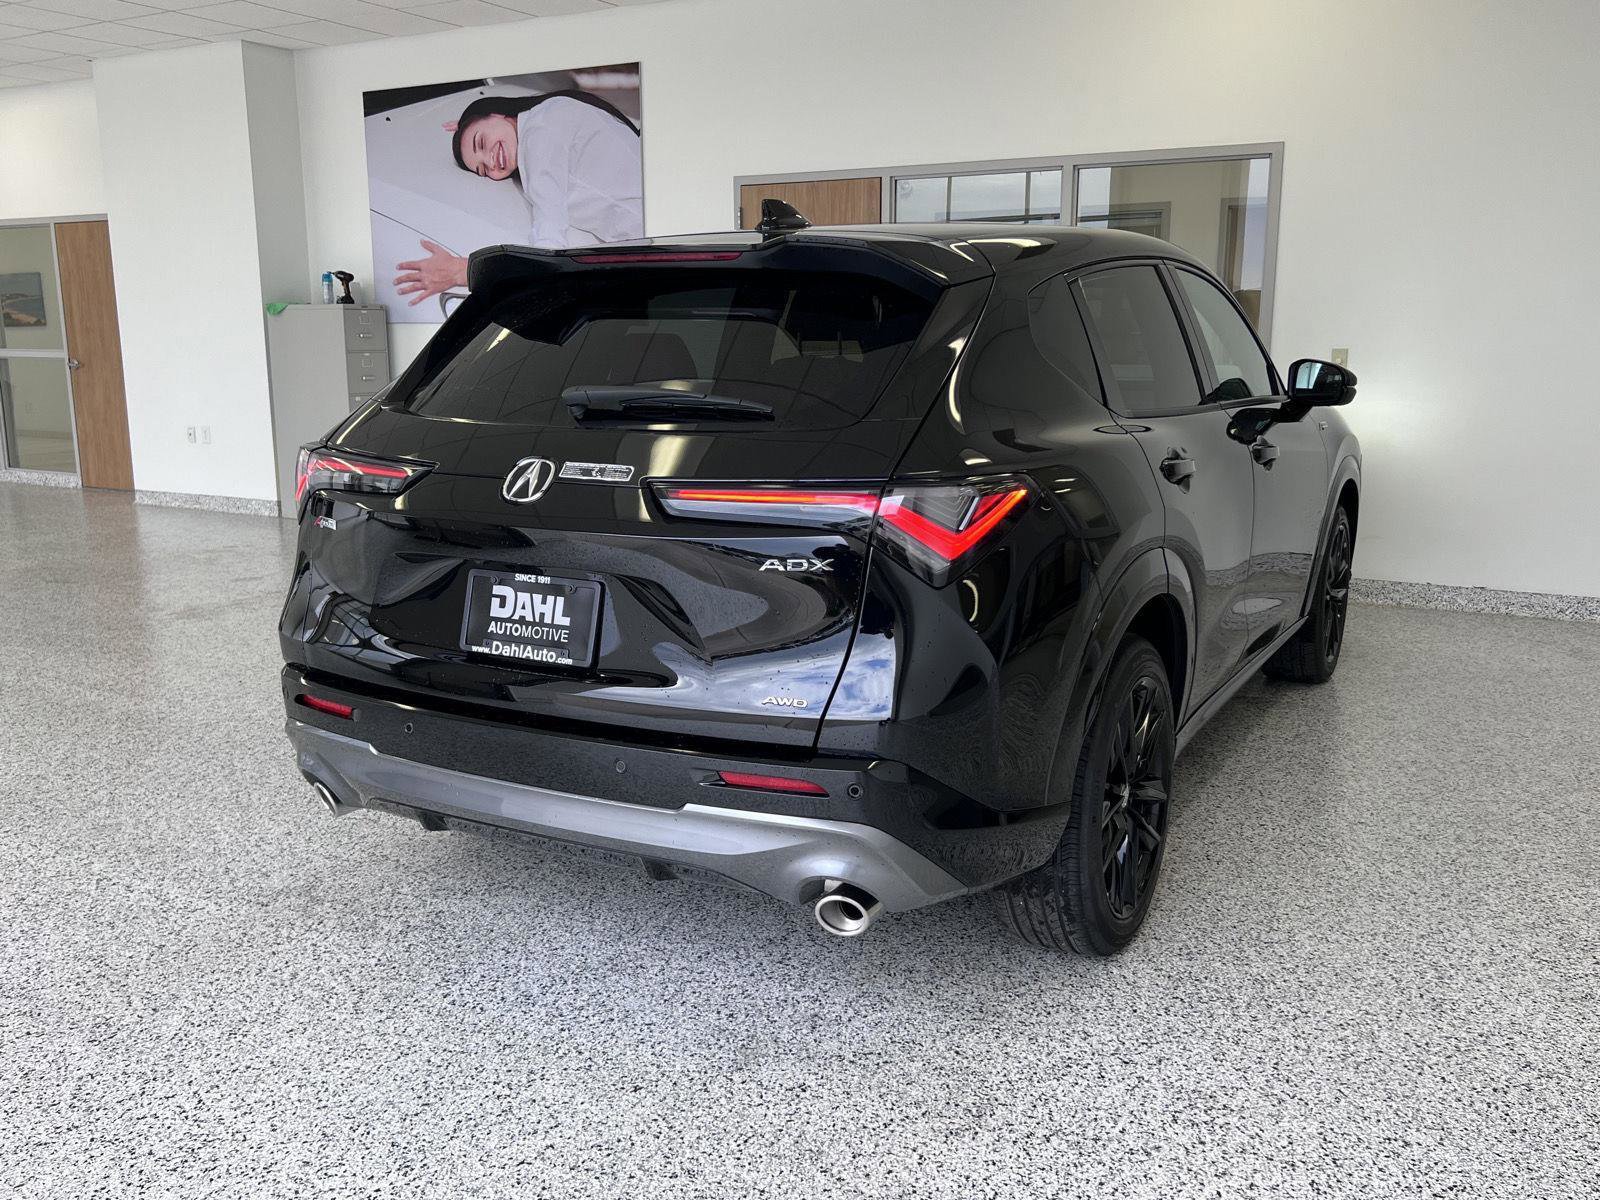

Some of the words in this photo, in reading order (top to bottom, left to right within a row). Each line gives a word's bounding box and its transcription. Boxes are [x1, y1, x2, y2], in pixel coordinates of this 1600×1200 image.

[759, 559, 834, 571] ADX
[515, 573, 536, 583] SINCE
[537, 575, 551, 584] 1911
[490, 585, 571, 626] DAHL
[488, 621, 570, 642] AUTOMOTIVE
[472, 641, 573, 665] www.DahlAuto.com
[762, 696, 808, 709] AWD
